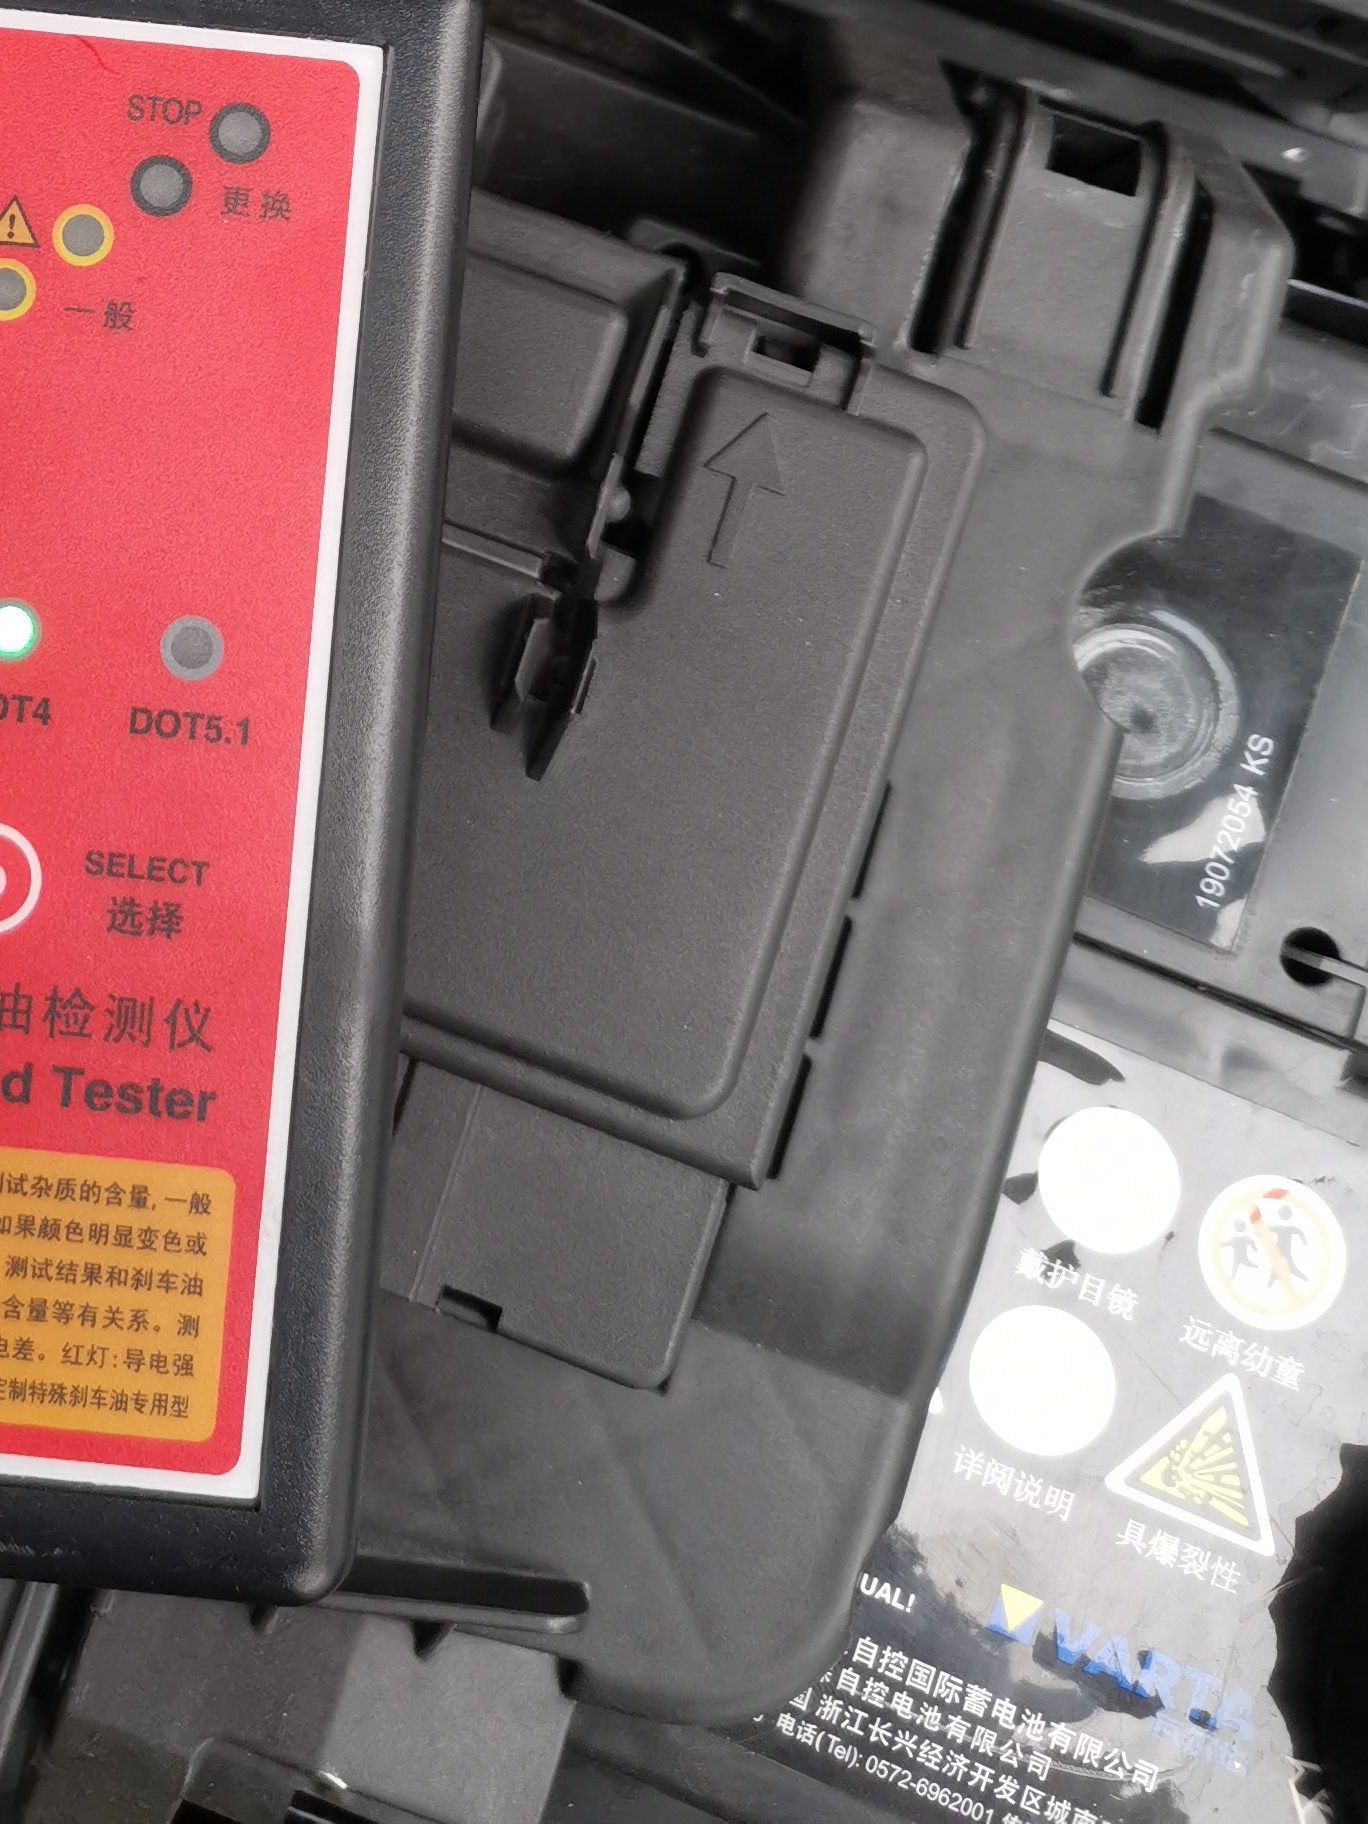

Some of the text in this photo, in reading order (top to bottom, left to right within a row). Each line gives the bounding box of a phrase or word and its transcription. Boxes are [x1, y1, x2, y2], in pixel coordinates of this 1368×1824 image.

[126, 93, 203, 126] STOP
[219, 185, 293, 222] 更换
[63, 298, 135, 332] 一般
[128, 705, 250, 747] DOT5.1
[1194, 733, 1275, 908] 19072054 KS
[84, 849, 210, 887] SELECT
[106, 896, 184, 940] 选择
[51, 1064, 217, 1122] Tester
[1014, 1247, 1139, 1321] 戴护目镜
[1179, 1315, 1305, 1391] 远离幼童
[954, 1444, 1076, 1522] 详阅说明
[1116, 1518, 1241, 1595] 具爆裂性
[1055, 1607, 1256, 1744] VARTA
[820, 1667, 1052, 1781] 自控电池有限公司
